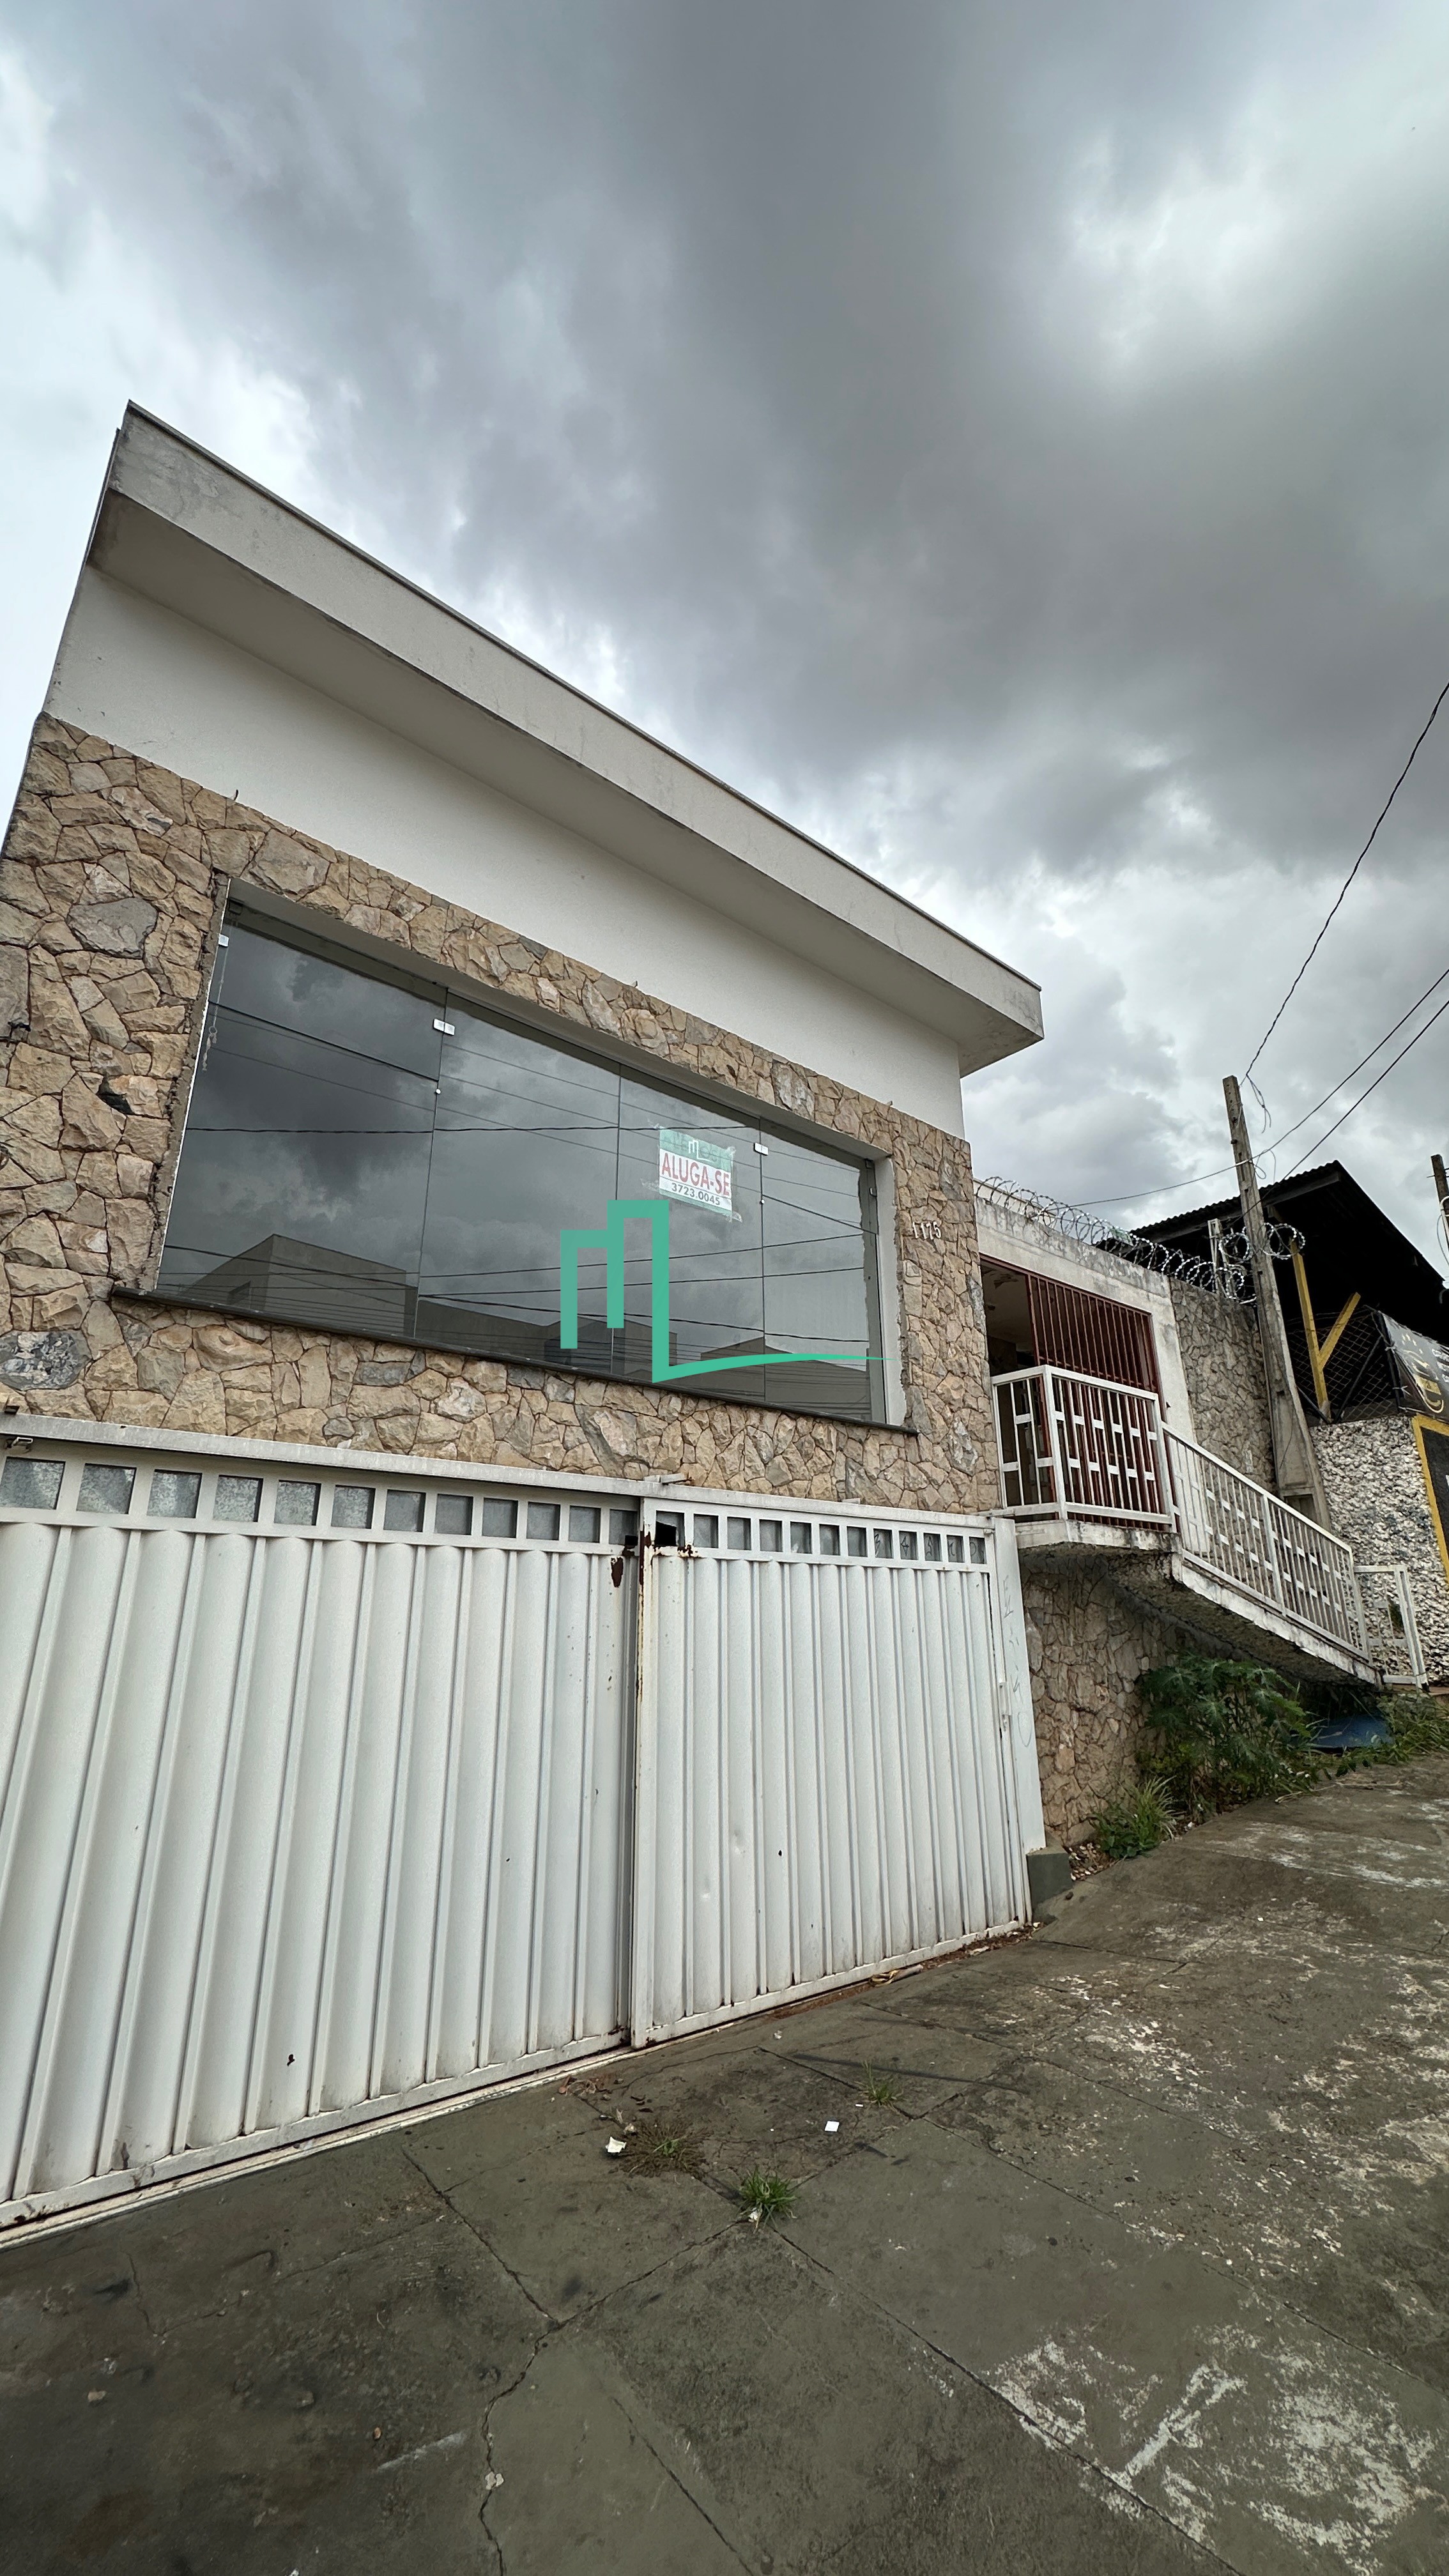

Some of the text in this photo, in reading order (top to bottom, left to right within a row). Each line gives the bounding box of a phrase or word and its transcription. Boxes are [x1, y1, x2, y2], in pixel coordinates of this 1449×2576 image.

[661, 1153, 730, 1196] ALUGA-SE
[671, 1183, 721, 1206] 3723.0045
[912, 1221, 942, 1240] 1175
